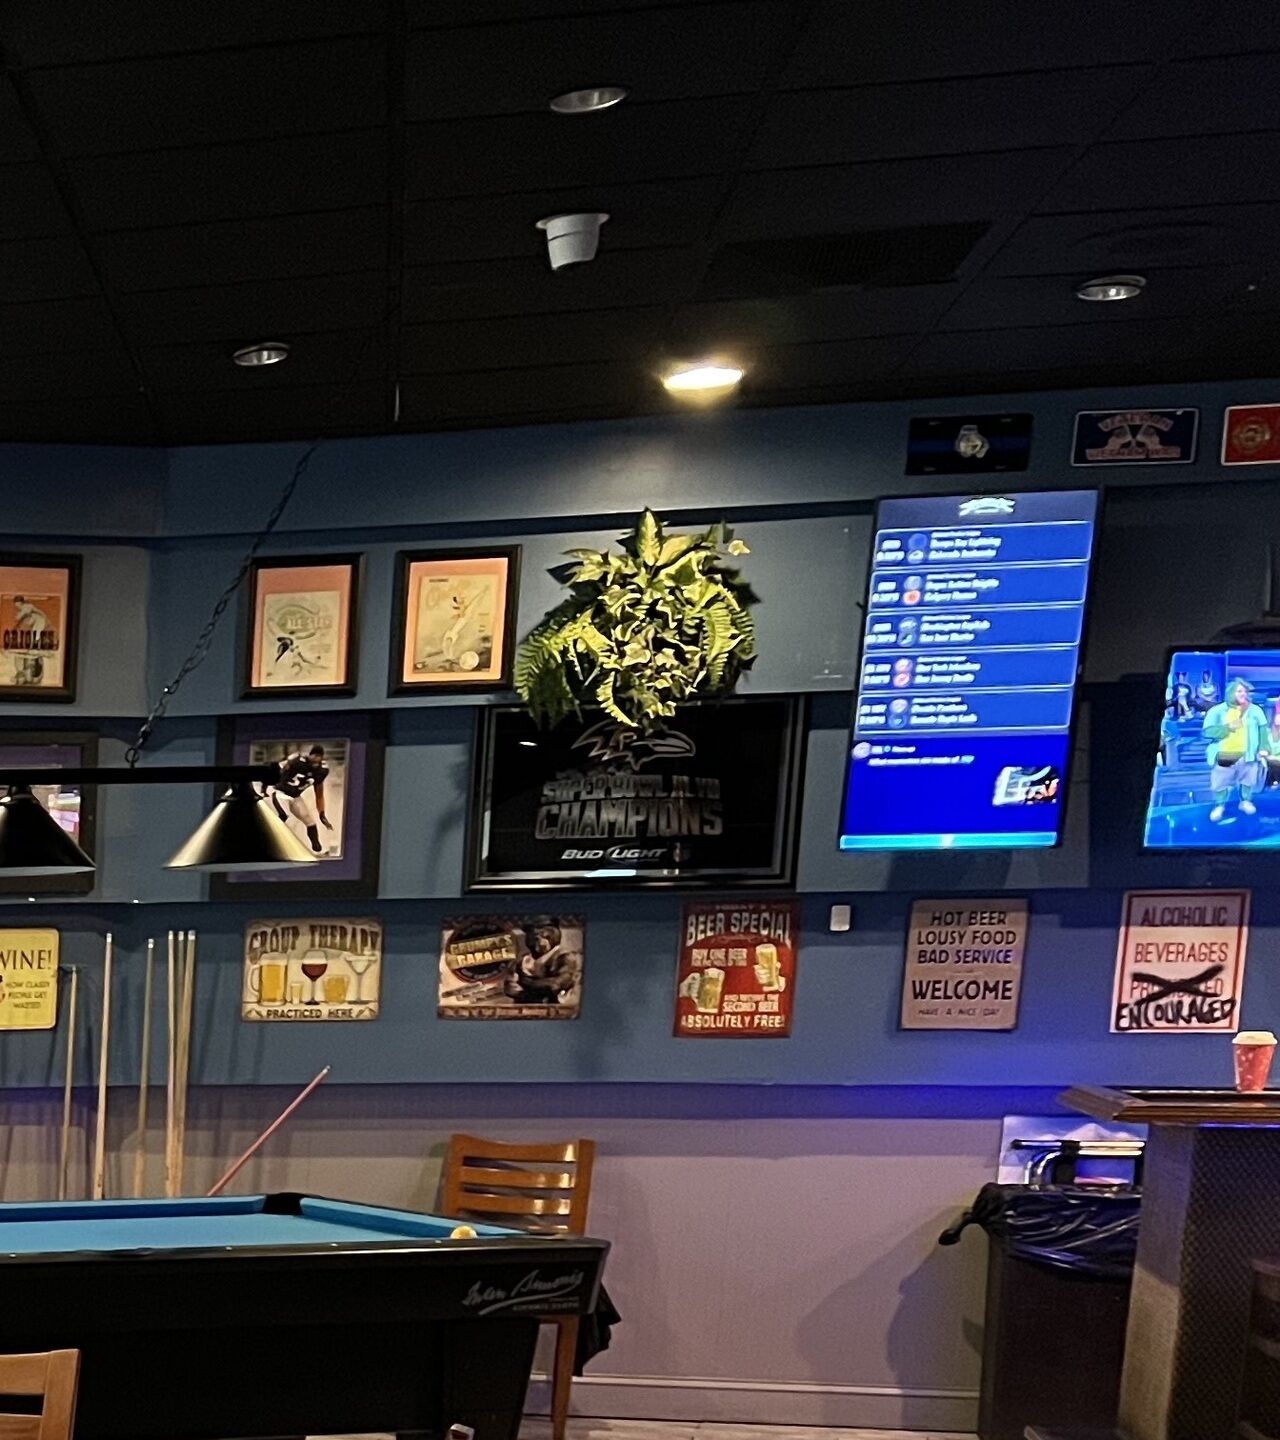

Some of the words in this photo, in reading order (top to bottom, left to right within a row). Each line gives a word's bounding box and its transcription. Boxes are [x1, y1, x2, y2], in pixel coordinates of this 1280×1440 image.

[3, 630, 56, 651] ORIOLES
[535, 798, 724, 840] CHAMPIONS
[561, 849, 604, 860] BUD
[609, 848, 668, 859] LIGHT
[930, 911, 964, 926] HOT
[968, 910, 1007, 926] BEER
[1141, 906, 1228, 927] ALCOHOLIC
[685, 912, 726, 947] BEER
[730, 911, 792, 951] SPECIAL
[917, 930, 967, 946] LOUSY
[971, 930, 1017, 945] FOOD
[248, 926, 300, 965] GROUP
[309, 924, 380, 956] THERAPY
[1134, 942, 1229, 963] BEVERAGES
[917, 949, 950, 964] BAD
[954, 949, 1013, 964] SERVICE
[912, 979, 1013, 1000] WELCOME
[266, 1008, 323, 1019] PRACTICED
[328, 1008, 354, 1019] HERE
[722, 1001, 756, 1013] SECOND
[1115, 998, 1237, 1031] ENCOURAGED
[681, 1014, 752, 1028] ABSOLUTELY
